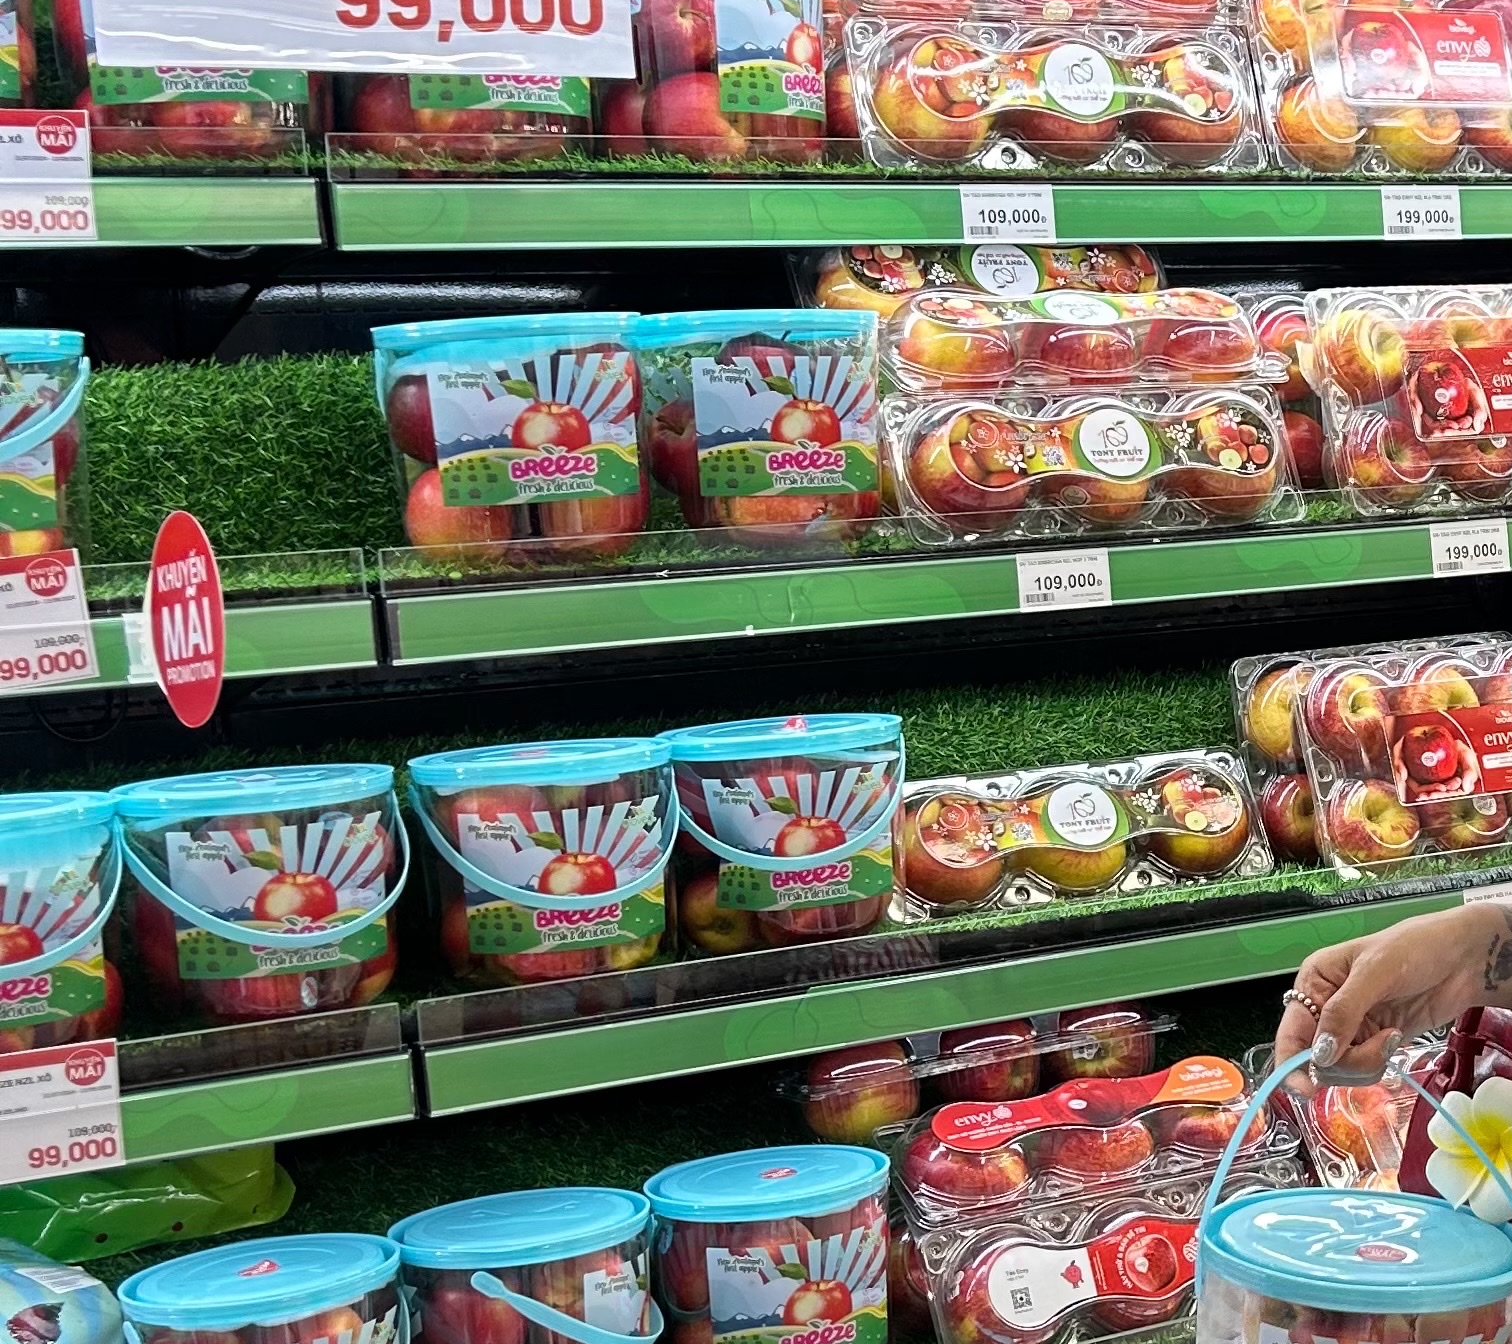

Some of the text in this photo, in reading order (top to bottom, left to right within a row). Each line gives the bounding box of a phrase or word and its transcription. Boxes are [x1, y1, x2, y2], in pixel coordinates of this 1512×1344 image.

[1436, 38, 1475, 62] envy
[0, 209, 89, 234] 99,000
[518, 481, 545, 495] fresh
[553, 478, 594, 493] delicious
[775, 474, 798, 487] fresh
[806, 474, 841, 487] delicious
[157, 548, 207, 592] KHUYẾN
[162, 584, 214, 662] MÃI
[0, 648, 88, 681] 99,000
[166, 659, 216, 685] PROMOTION
[778, 889, 803, 903] fresh
[811, 884, 848, 900] delicious
[541, 929, 568, 944] fresh
[578, 923, 618, 941] delicious
[259, 954, 287, 967] fresh
[954, 1110, 993, 1127] envy
[28, 1136, 118, 1169] 99,000
